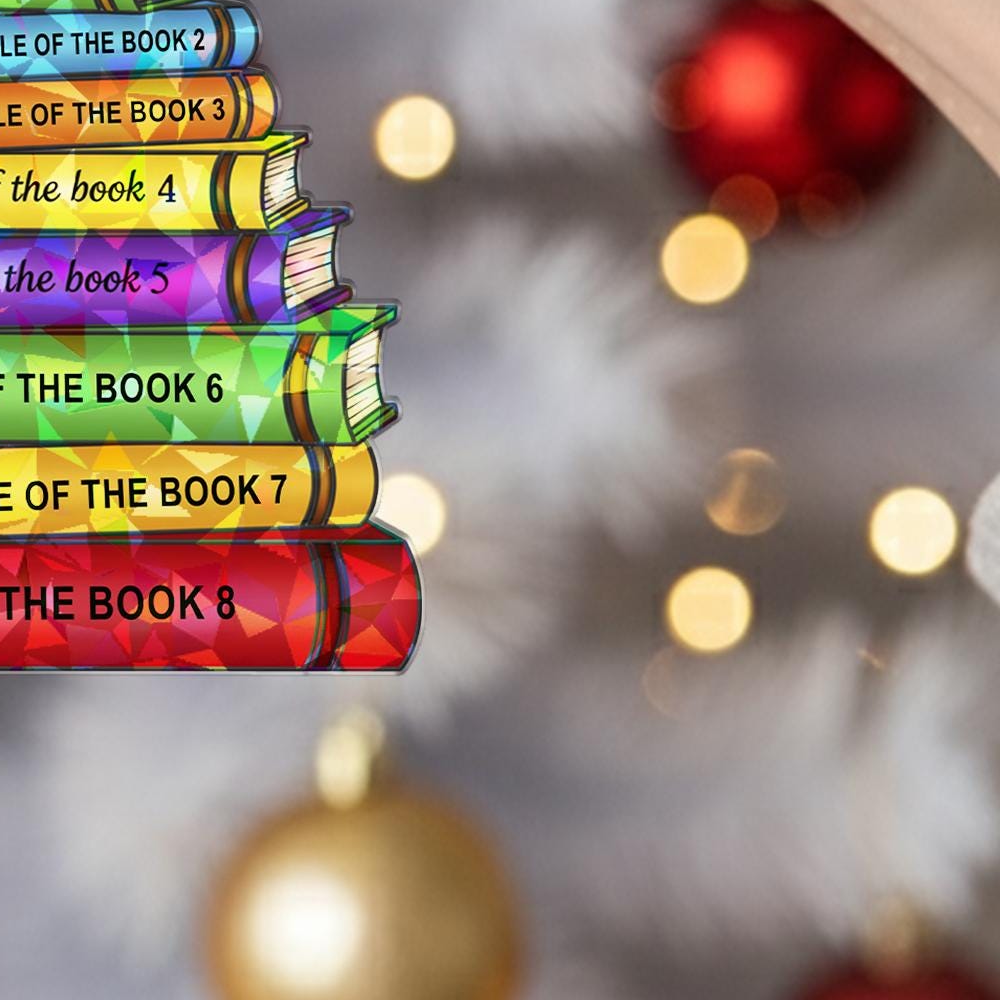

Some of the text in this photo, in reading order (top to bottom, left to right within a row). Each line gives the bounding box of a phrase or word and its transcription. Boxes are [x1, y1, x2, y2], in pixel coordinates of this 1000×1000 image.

[35, 34, 63, 55] OF
[71, 32, 114, 54] THE
[123, 30, 186, 52] BOOK
[194, 29, 205, 50] 2
[32, 103, 63, 125] OF
[73, 102, 121, 124] THE
[131, 99, 204, 122] BOOK
[213, 99, 225, 120] 3
[12, 171, 60, 202] the
[71, 170, 145, 202] book
[157, 174, 176, 202] 4
[5, 260, 53, 293] the
[65, 260, 141, 293] book
[151, 262, 169, 294] 5
[17, 374, 83, 403] THE
[97, 373, 195, 403] BOOK
[206, 374, 223, 403] 6
[26, 481, 68, 510] OF
[81, 478, 147, 509] THE
[161, 475, 260, 507] BOOK
[271, 475, 287, 504] 7
[0, 587, 73, 620] THE
[90, 586, 203, 620] BOOK
[217, 586, 235, 620] 8
